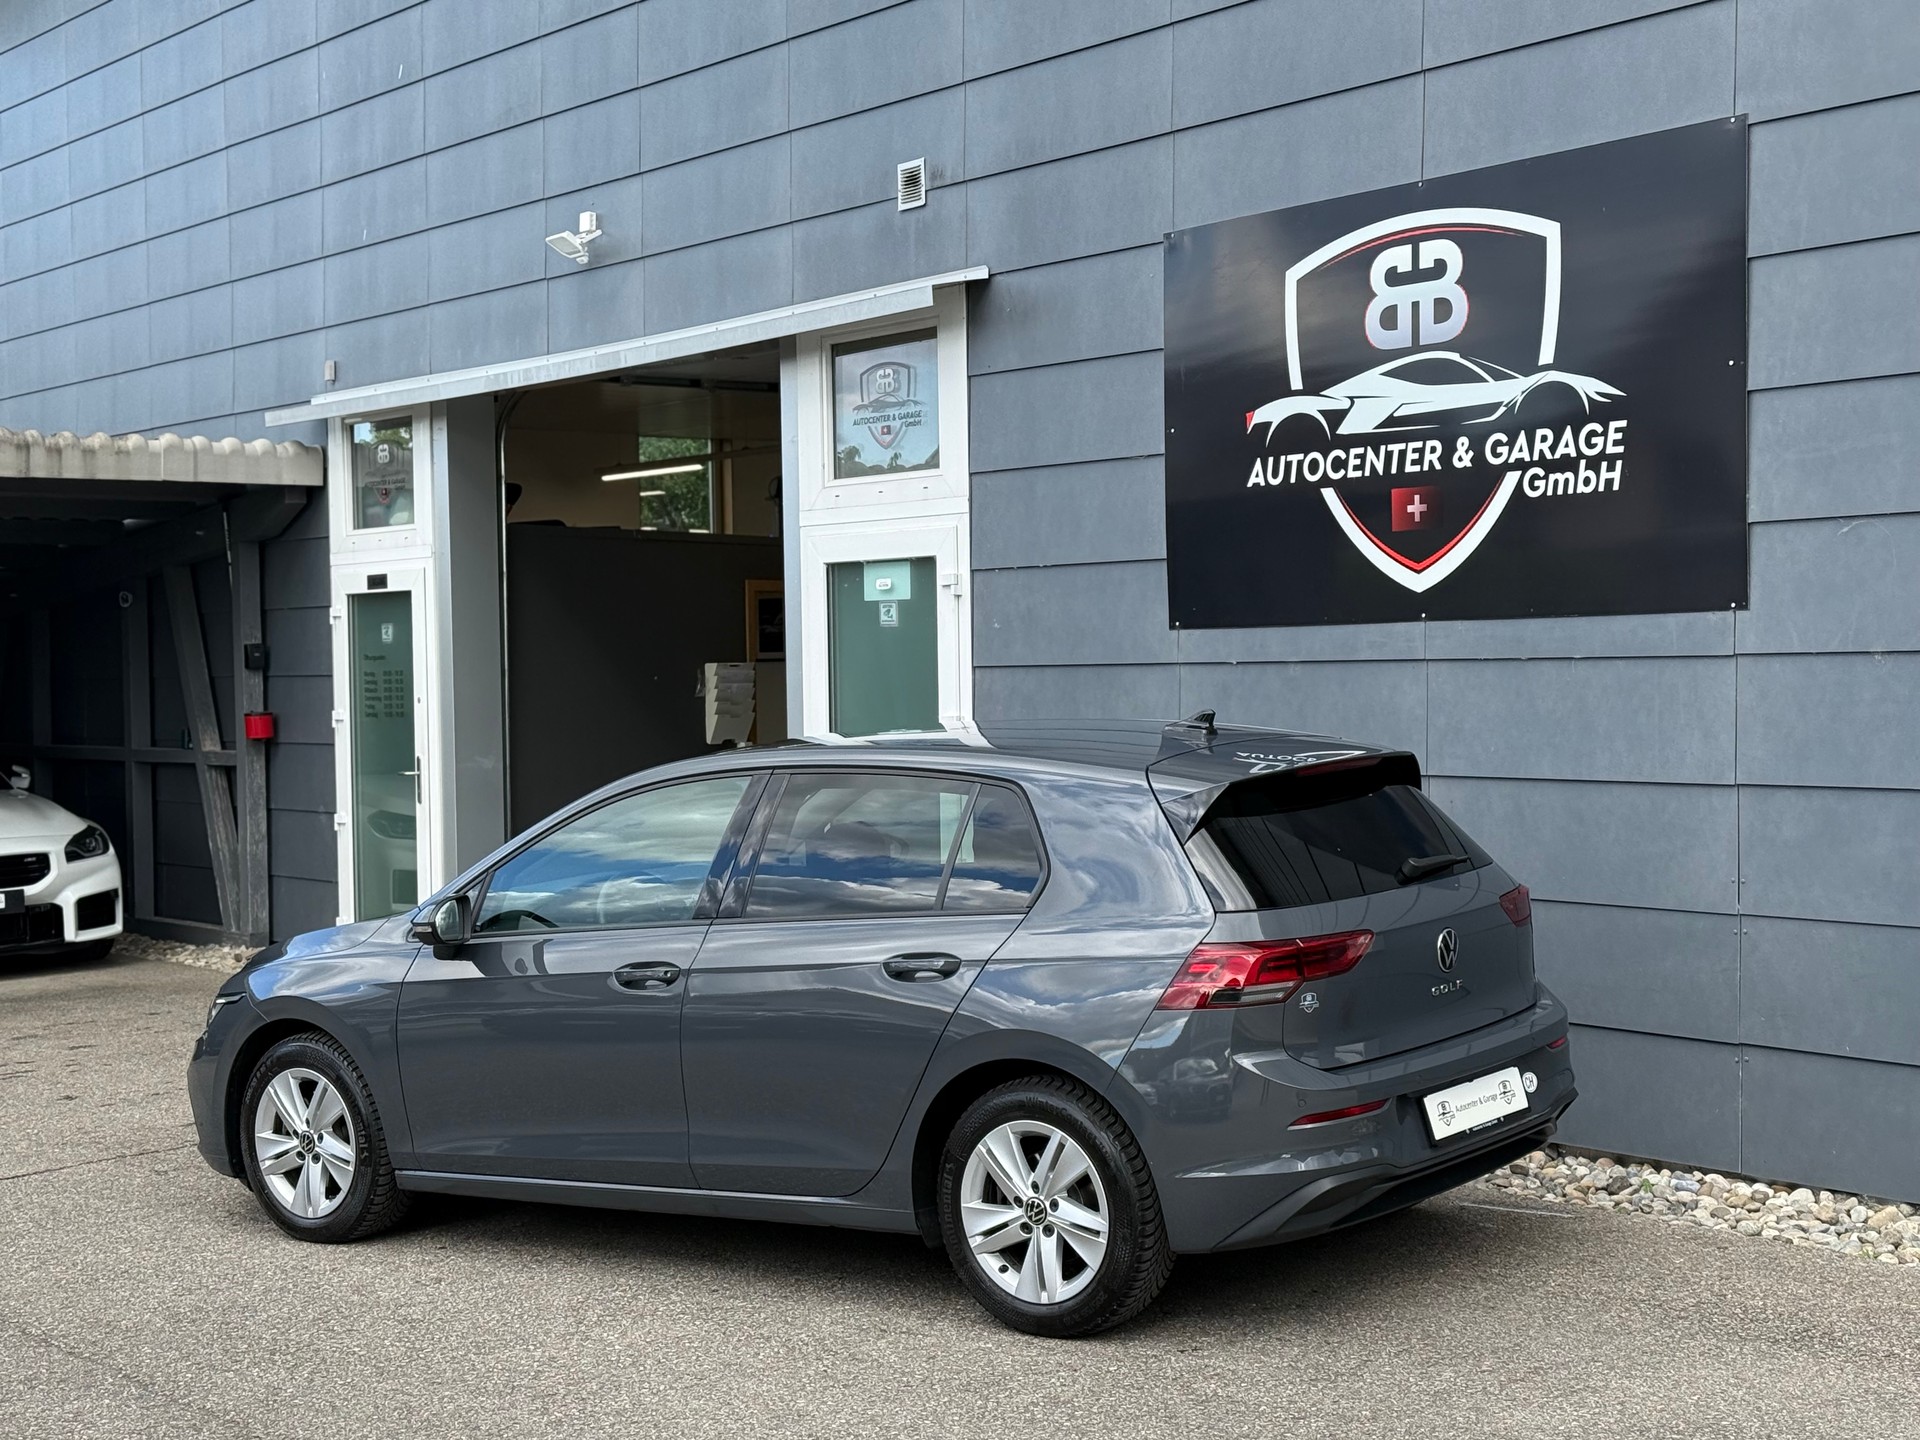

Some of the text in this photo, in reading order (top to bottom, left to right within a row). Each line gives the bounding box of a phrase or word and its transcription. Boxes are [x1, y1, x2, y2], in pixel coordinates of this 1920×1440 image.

[852, 414, 890, 426] AUTOCENTER
[897, 410, 922, 420] GARAGE
[1246, 420, 1628, 488] AUTOCENTER & GARAGE
[1522, 460, 1623, 498] GmbH
[1432, 979, 1463, 996] GOLF
[1524, 1076, 1535, 1089] CH
